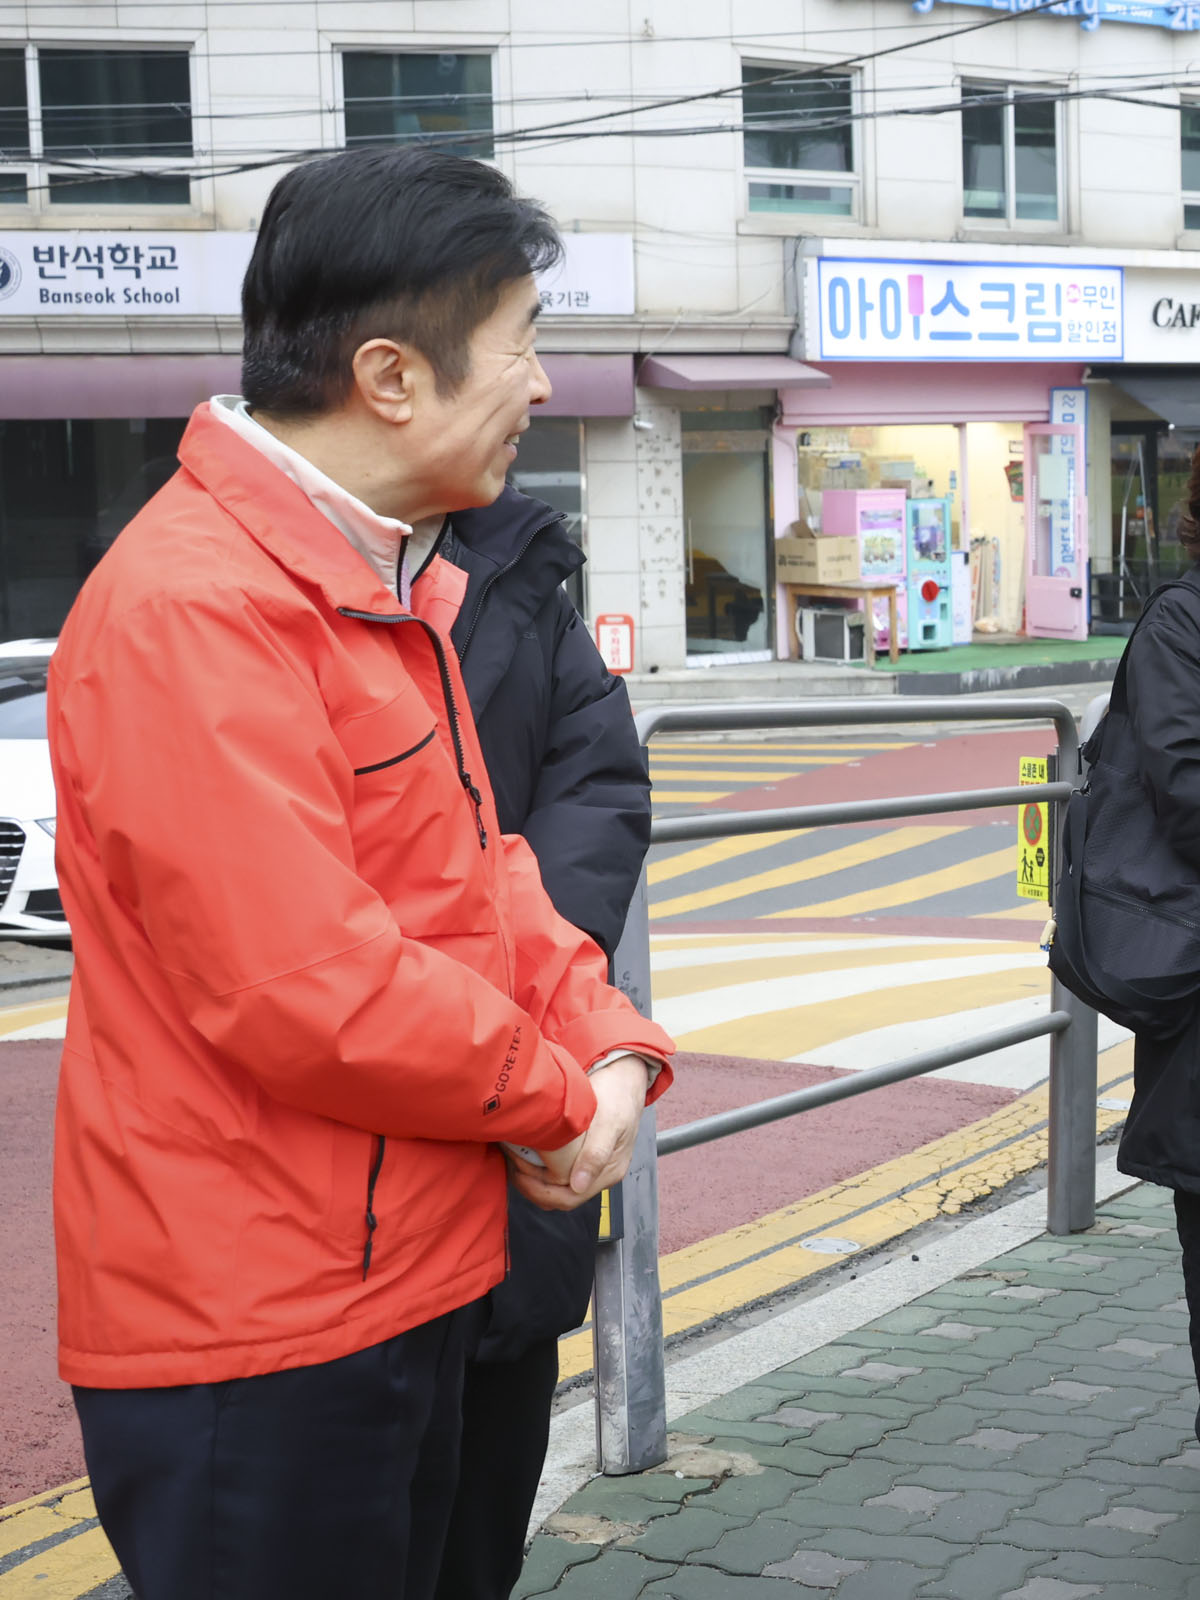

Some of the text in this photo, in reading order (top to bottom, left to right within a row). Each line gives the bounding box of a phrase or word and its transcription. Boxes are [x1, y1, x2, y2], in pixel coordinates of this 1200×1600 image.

[33, 243, 178, 279] 반석학교
[39, 287, 180, 304] Banseok School
[828, 274, 1062, 343] 아이스크림
[1083, 285, 1115, 310] 무인
[1067, 320, 1117, 343] 할인점
[495, 1025, 522, 1093] GORE-TEX
